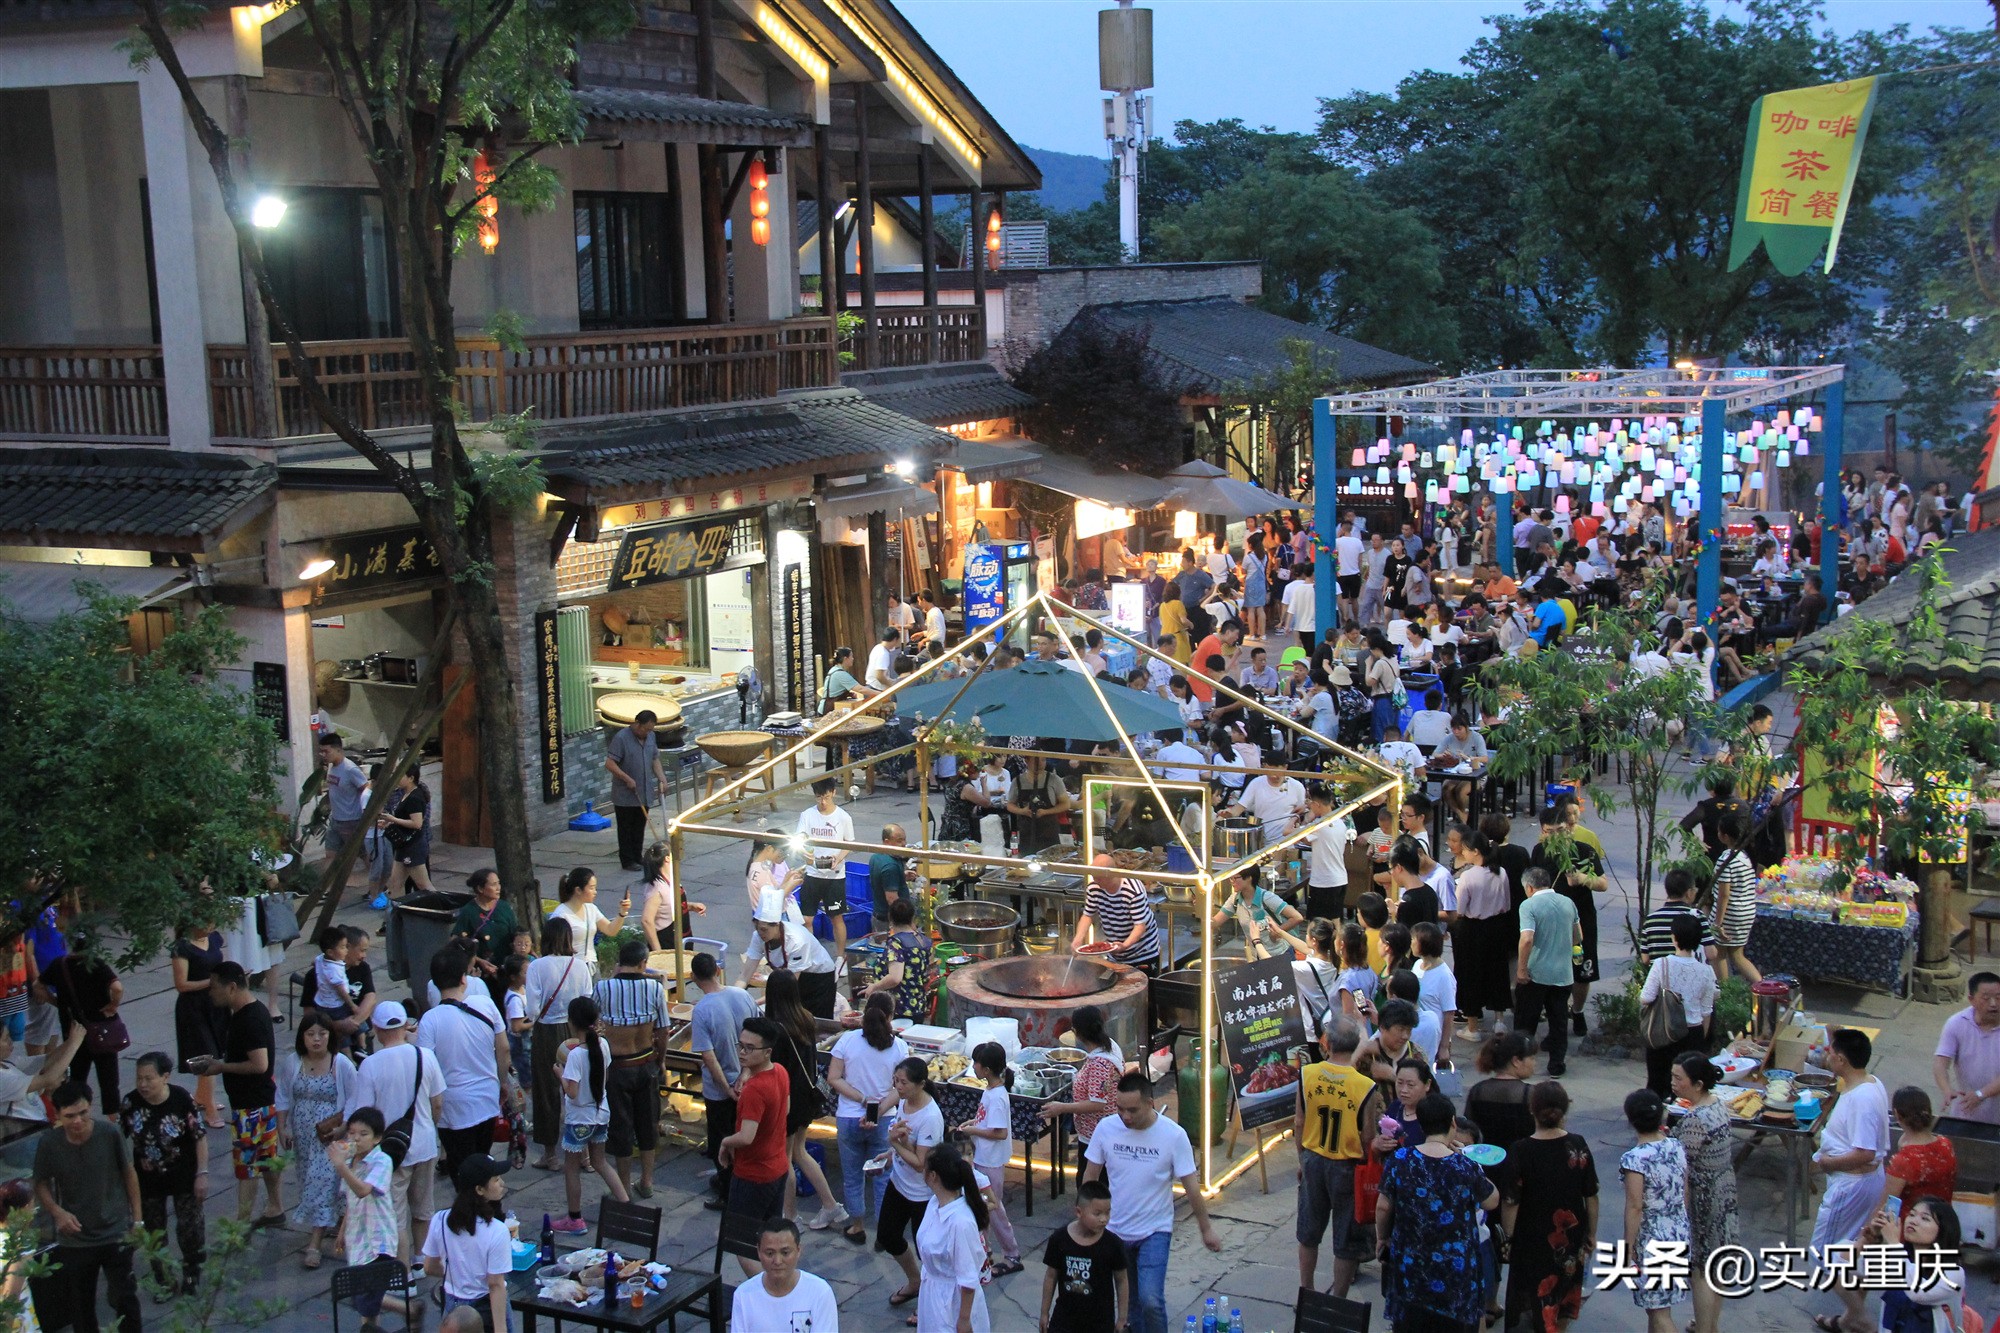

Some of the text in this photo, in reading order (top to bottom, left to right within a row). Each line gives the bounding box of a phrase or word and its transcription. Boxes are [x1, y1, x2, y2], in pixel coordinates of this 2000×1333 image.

[1771, 110, 1857, 139] 咖啡
[1781, 149, 1831, 181] 茶
[1759, 187, 1840, 219] 简餐
[635, 483, 767, 520] 刘家四合胡豆
[970, 559, 999, 579] 脉动
[1232, 975, 1283, 1001] 南山首届
[1224, 993, 1296, 1025] 雪花啤酒龙虾节
[1317, 1104, 1343, 1154] 11
[1066, 1259, 1092, 1271] BABY
